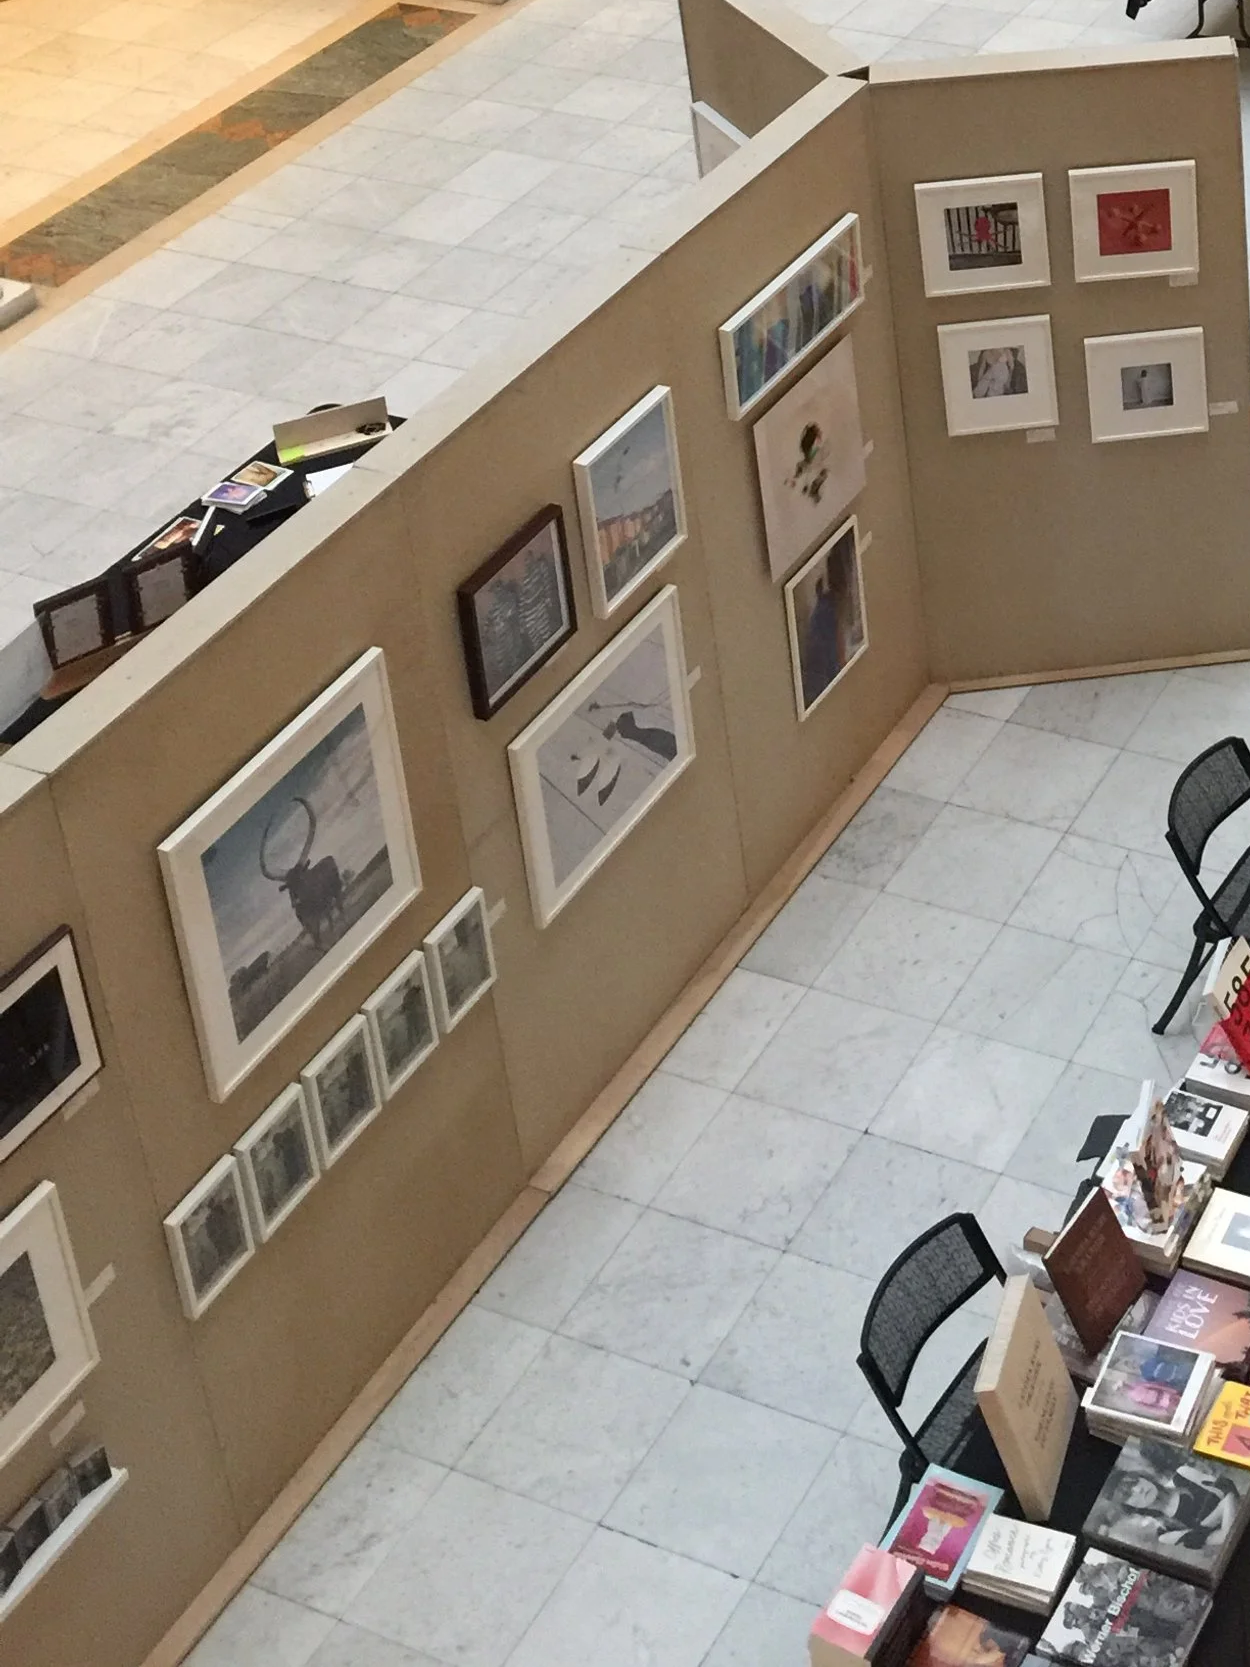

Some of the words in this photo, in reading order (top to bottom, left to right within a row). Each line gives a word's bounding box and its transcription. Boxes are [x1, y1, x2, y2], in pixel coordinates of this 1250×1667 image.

[1164, 1302, 1192, 1334] KIDS
[1182, 1285, 1201, 1301] IN
[1178, 1289, 1218, 1340] LOVE
[1206, 1419, 1229, 1446] THIS
[1078, 1618, 1114, 1664] Werner
[1107, 1567, 1141, 1616] Bischof
